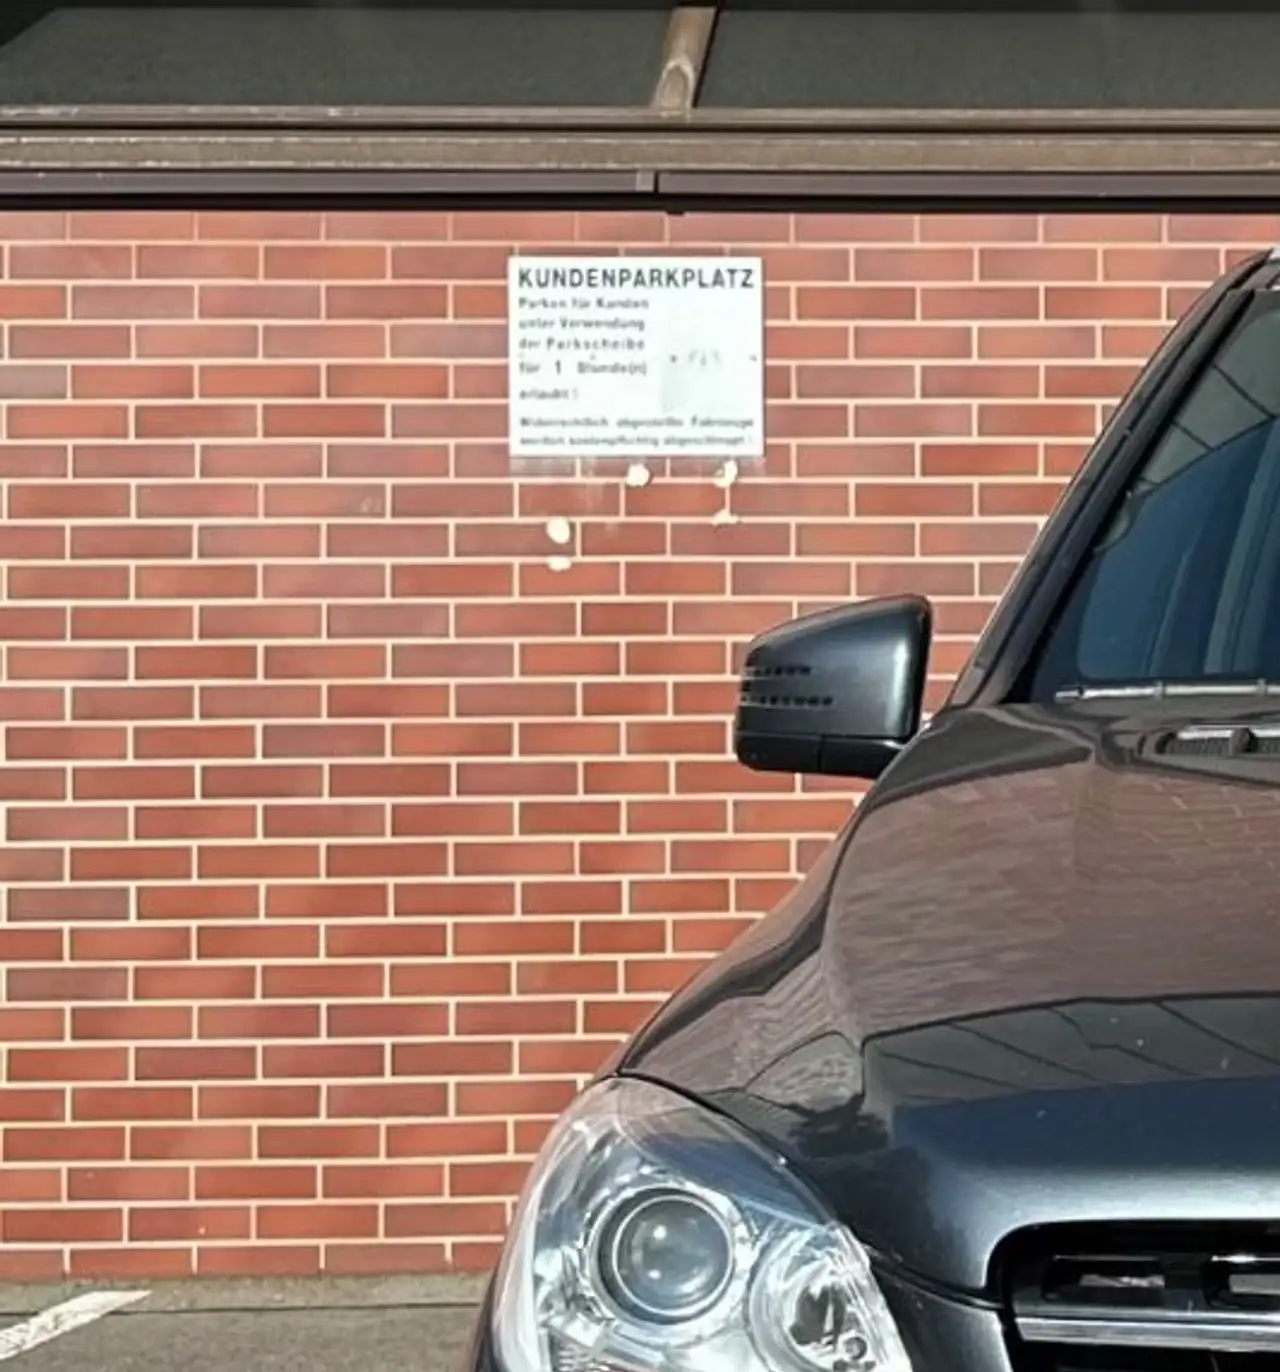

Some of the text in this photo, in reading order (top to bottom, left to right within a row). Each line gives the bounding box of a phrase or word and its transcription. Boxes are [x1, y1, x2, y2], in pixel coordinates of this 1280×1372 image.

[517, 267, 755, 290] KUNDENPARKPLATZ
[518, 297, 650, 310] Parken für Kunden
[558, 316, 646, 333] Verwendung
[518, 337, 646, 351] der Parkscheibe
[518, 361, 541, 374] für
